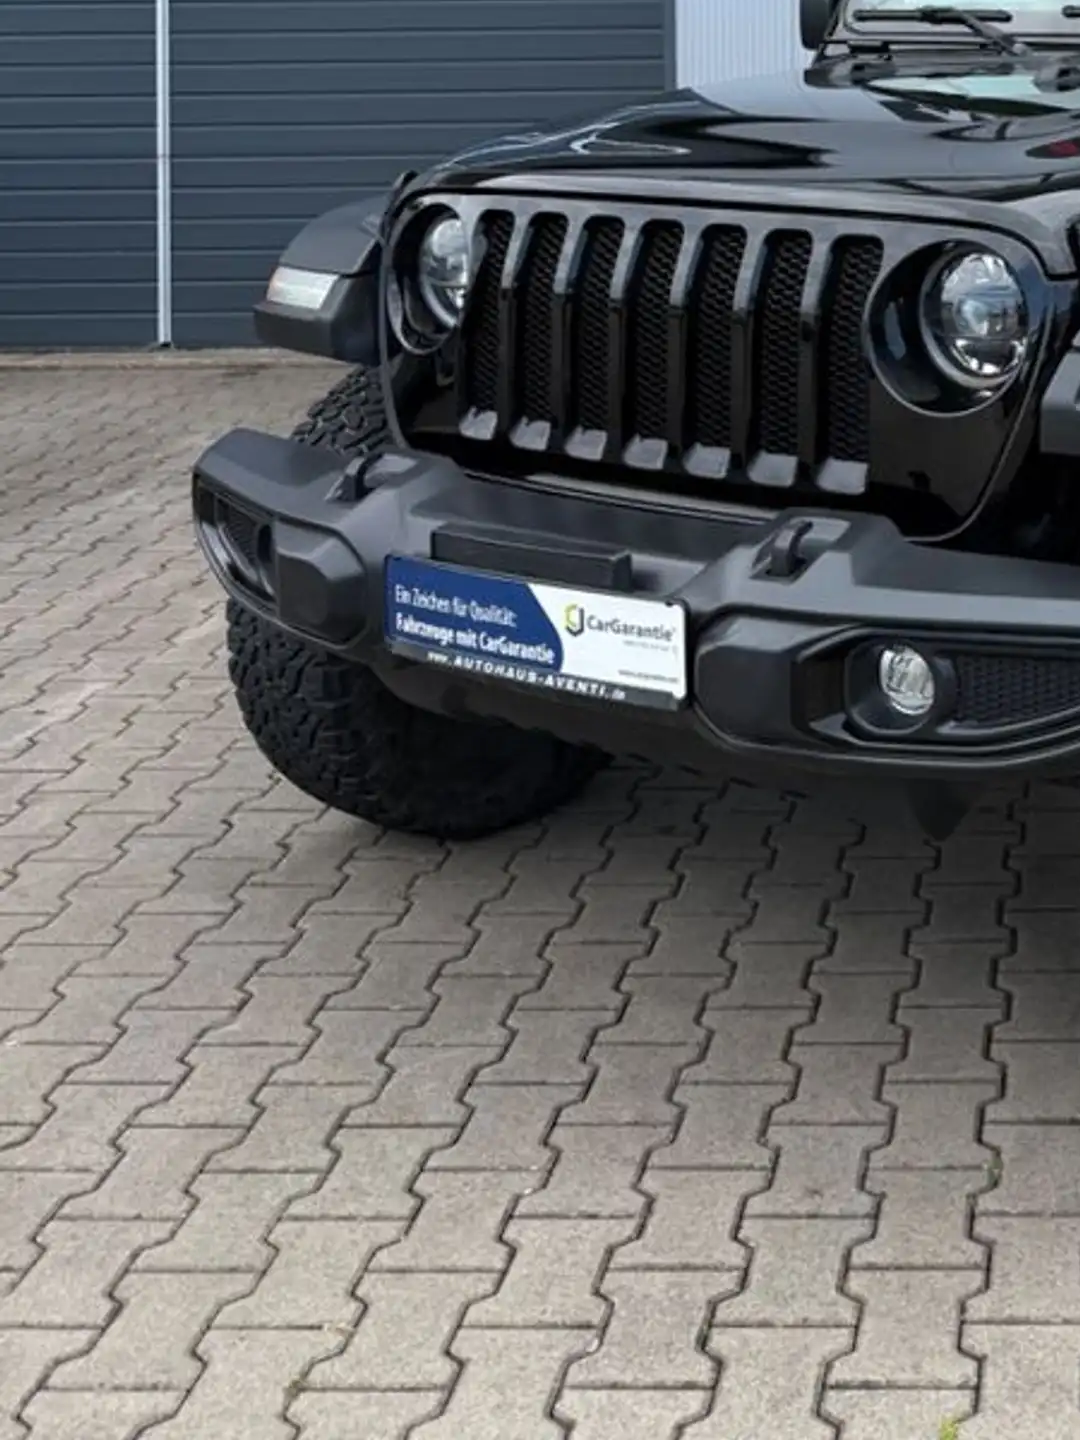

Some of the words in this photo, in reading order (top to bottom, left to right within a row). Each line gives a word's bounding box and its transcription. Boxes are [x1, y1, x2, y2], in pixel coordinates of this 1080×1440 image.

[394, 583, 411, 604] Ein
[412, 588, 450, 616] Zeichen
[453, 595, 468, 618] für
[396, 612, 454, 646] Fahrzeuge
[456, 628, 477, 650] mit
[479, 631, 555, 664] CarGarantie
